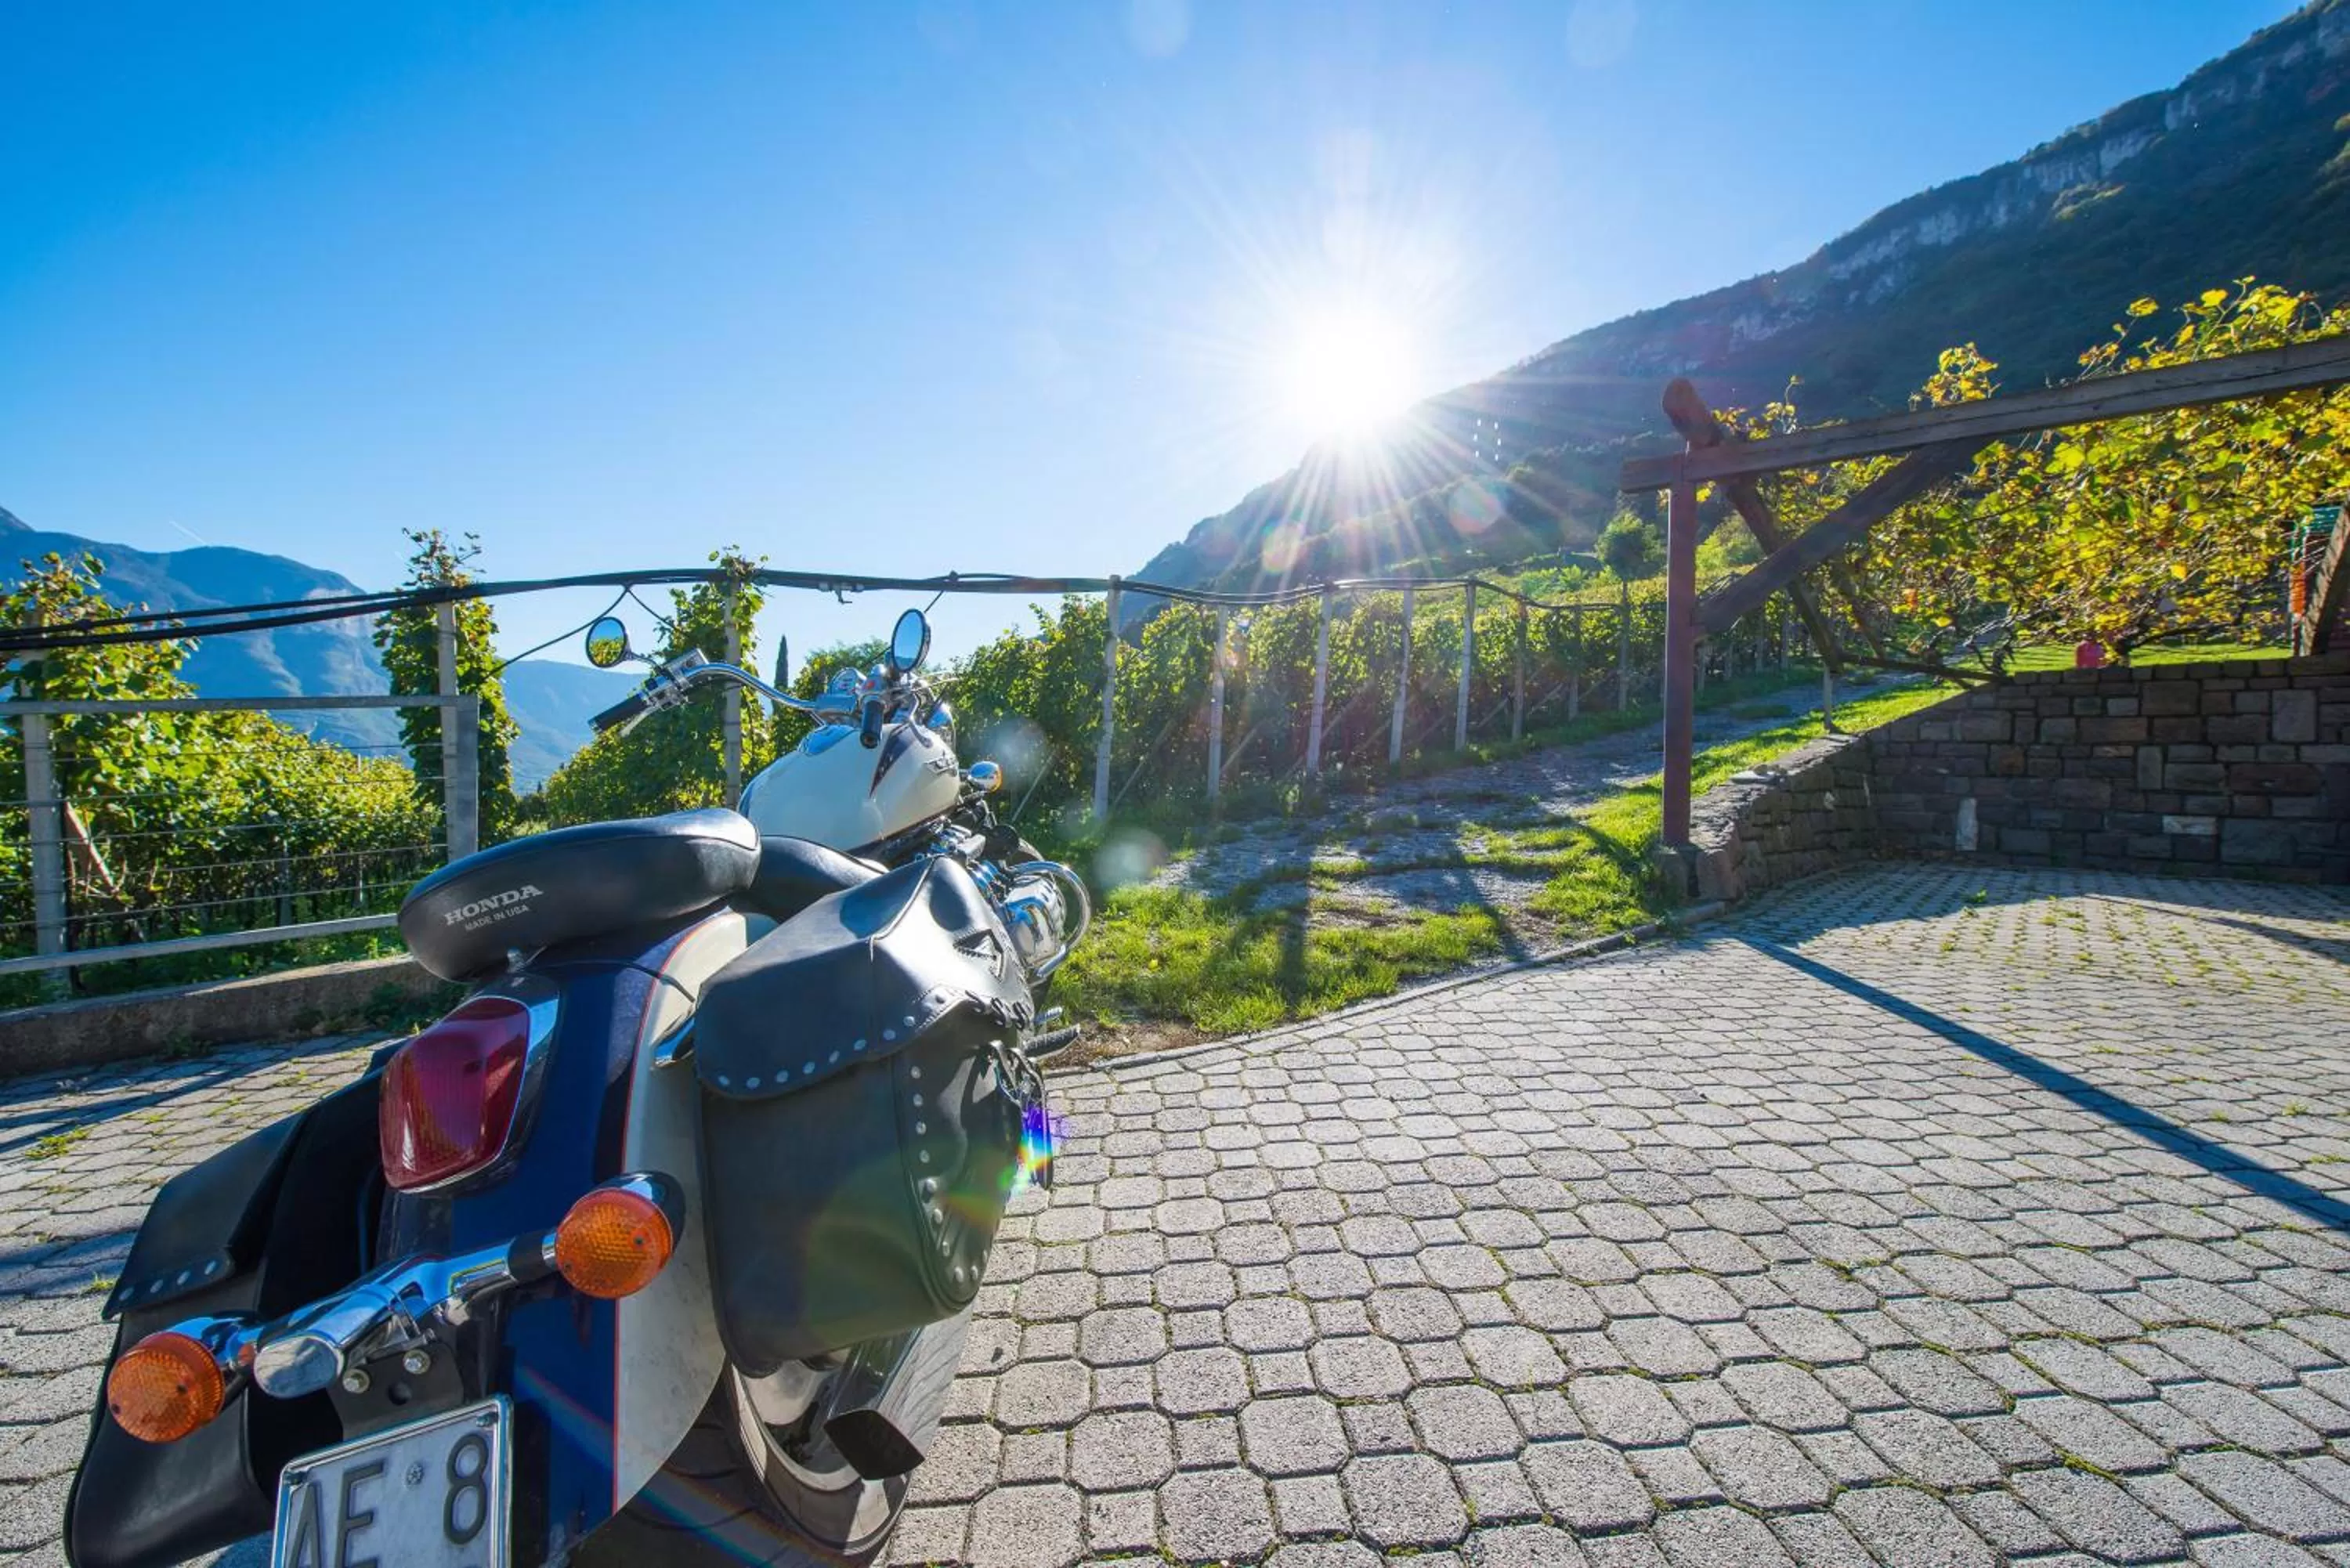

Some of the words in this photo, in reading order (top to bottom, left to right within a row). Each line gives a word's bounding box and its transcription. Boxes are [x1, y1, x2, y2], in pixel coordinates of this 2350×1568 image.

[444, 884, 544, 926] HONDA
[465, 916, 493, 930] MADE
[443, 1433, 489, 1545] 8
